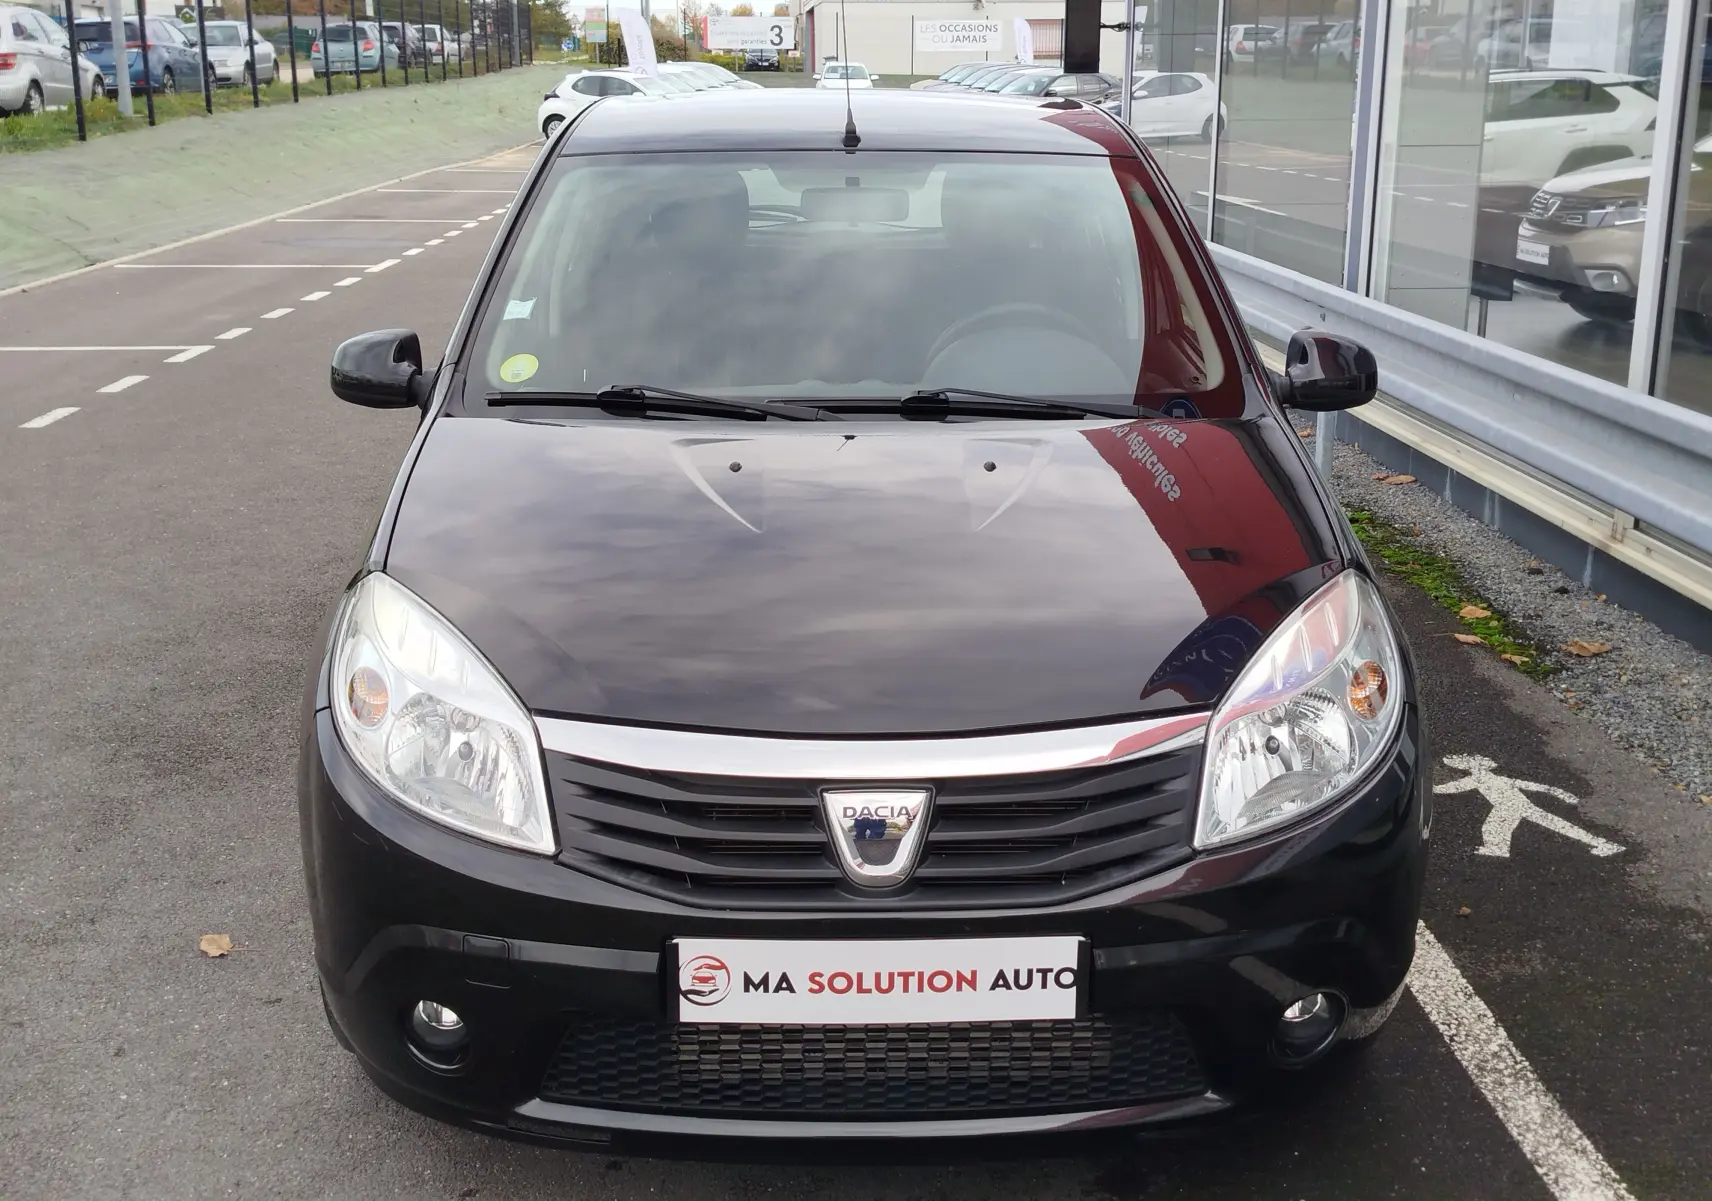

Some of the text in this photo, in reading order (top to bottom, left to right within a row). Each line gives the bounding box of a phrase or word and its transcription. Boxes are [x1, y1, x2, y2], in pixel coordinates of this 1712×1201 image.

[920, 23, 999, 33] LES OCCASIONS
[769, 24, 784, 47] 3
[932, 34, 988, 43] OU JAMAIS
[842, 806, 912, 819] DACIA
[743, 966, 1078, 995] MA SOLUTION AUTO
